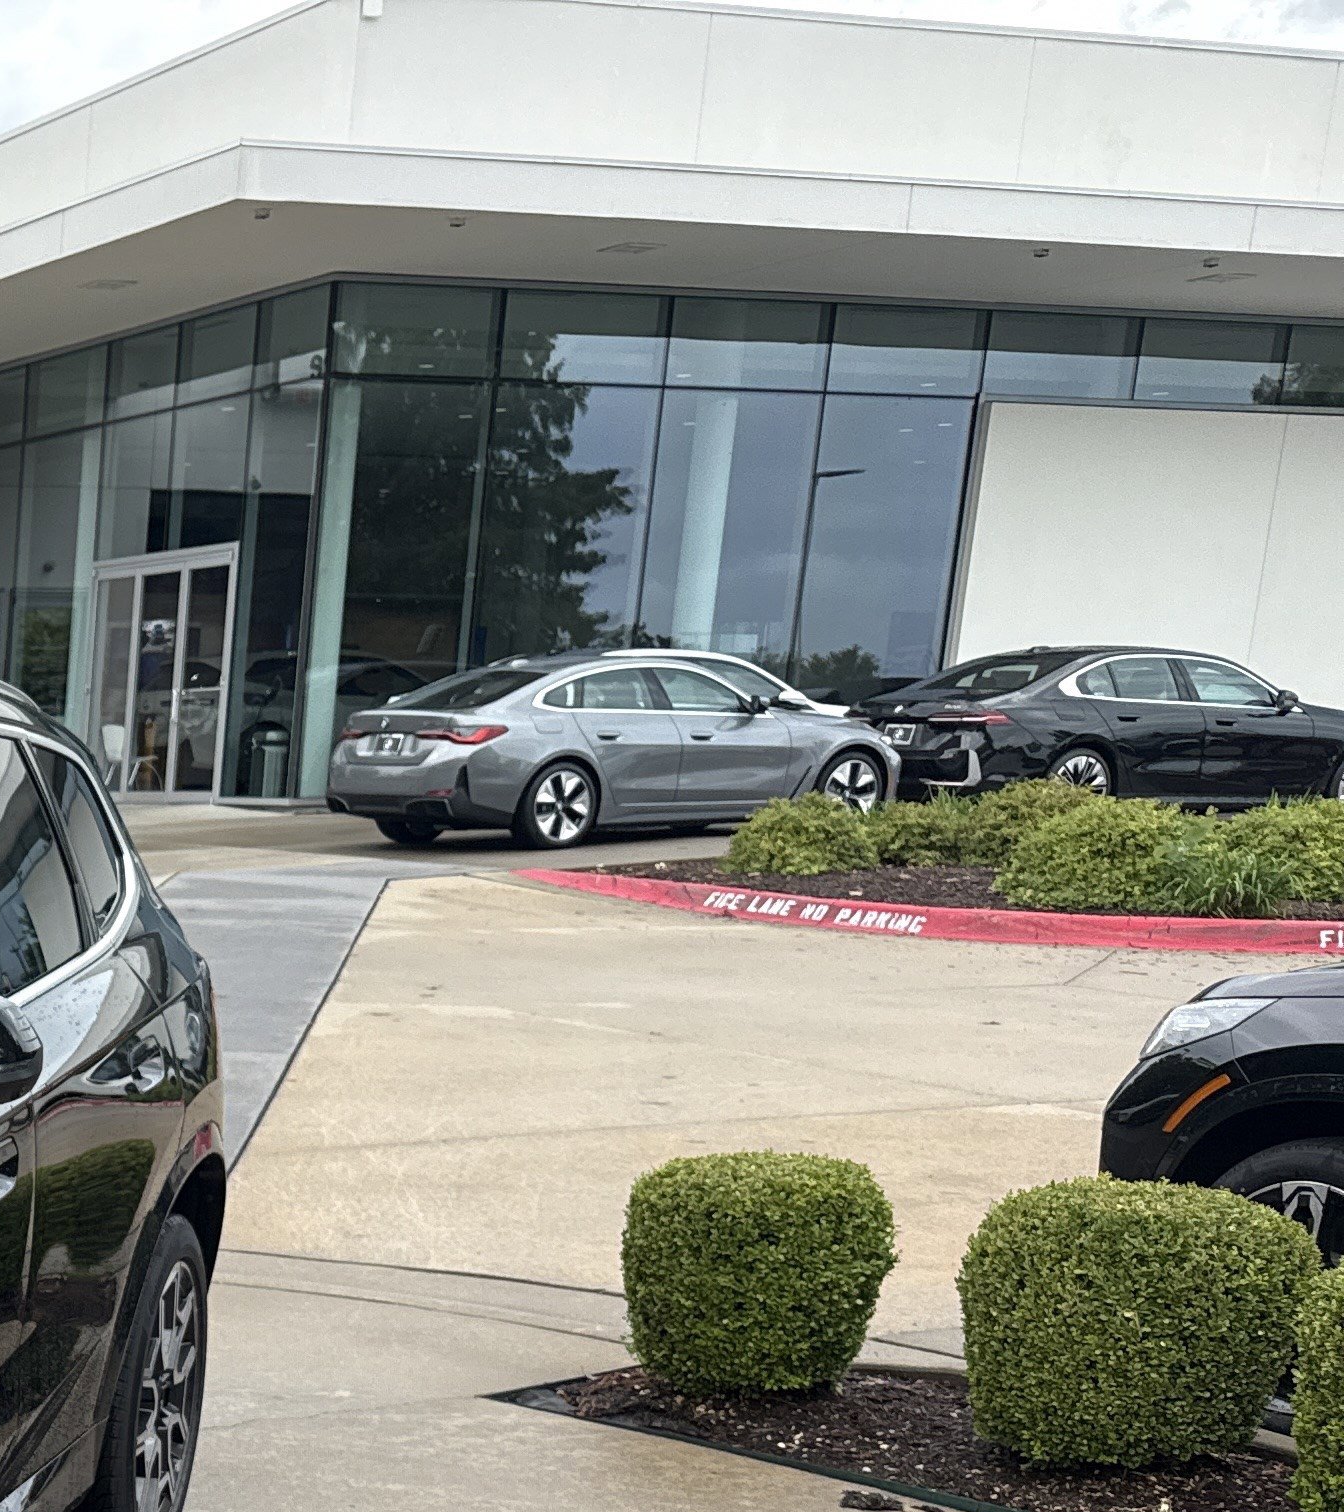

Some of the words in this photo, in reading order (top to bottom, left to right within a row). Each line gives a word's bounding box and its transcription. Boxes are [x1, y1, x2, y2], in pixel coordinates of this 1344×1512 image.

[703, 891, 745, 910] FIRE
[746, 896, 797, 916] LANE
[799, 904, 829, 921] NO
[833, 908, 927, 934] PARKING
